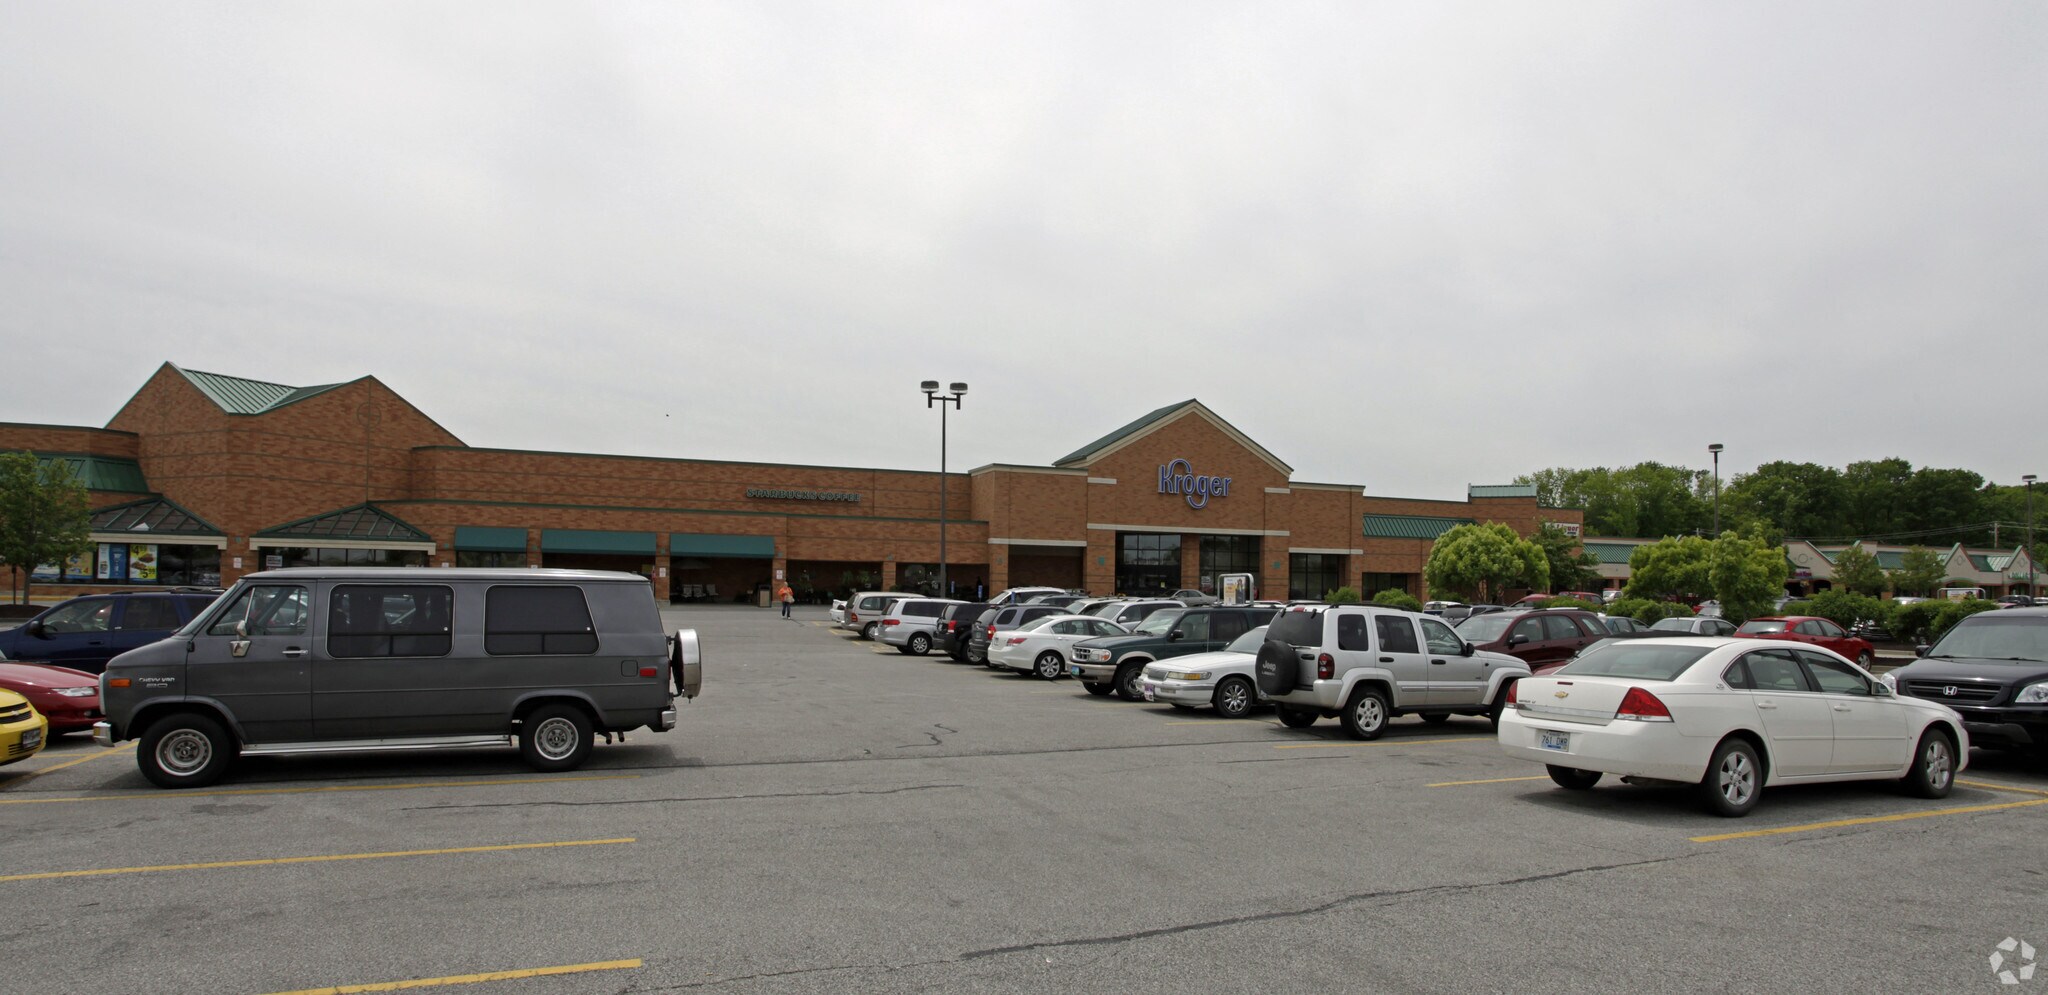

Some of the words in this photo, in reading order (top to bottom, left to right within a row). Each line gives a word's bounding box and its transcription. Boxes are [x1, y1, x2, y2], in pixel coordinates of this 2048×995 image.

[1158, 458, 1231, 509] Kroger
[746, 488, 818, 500] STARBUCKS
[819, 491, 863, 502] COFFEE
[1262, 660, 1276, 671] Jeep
